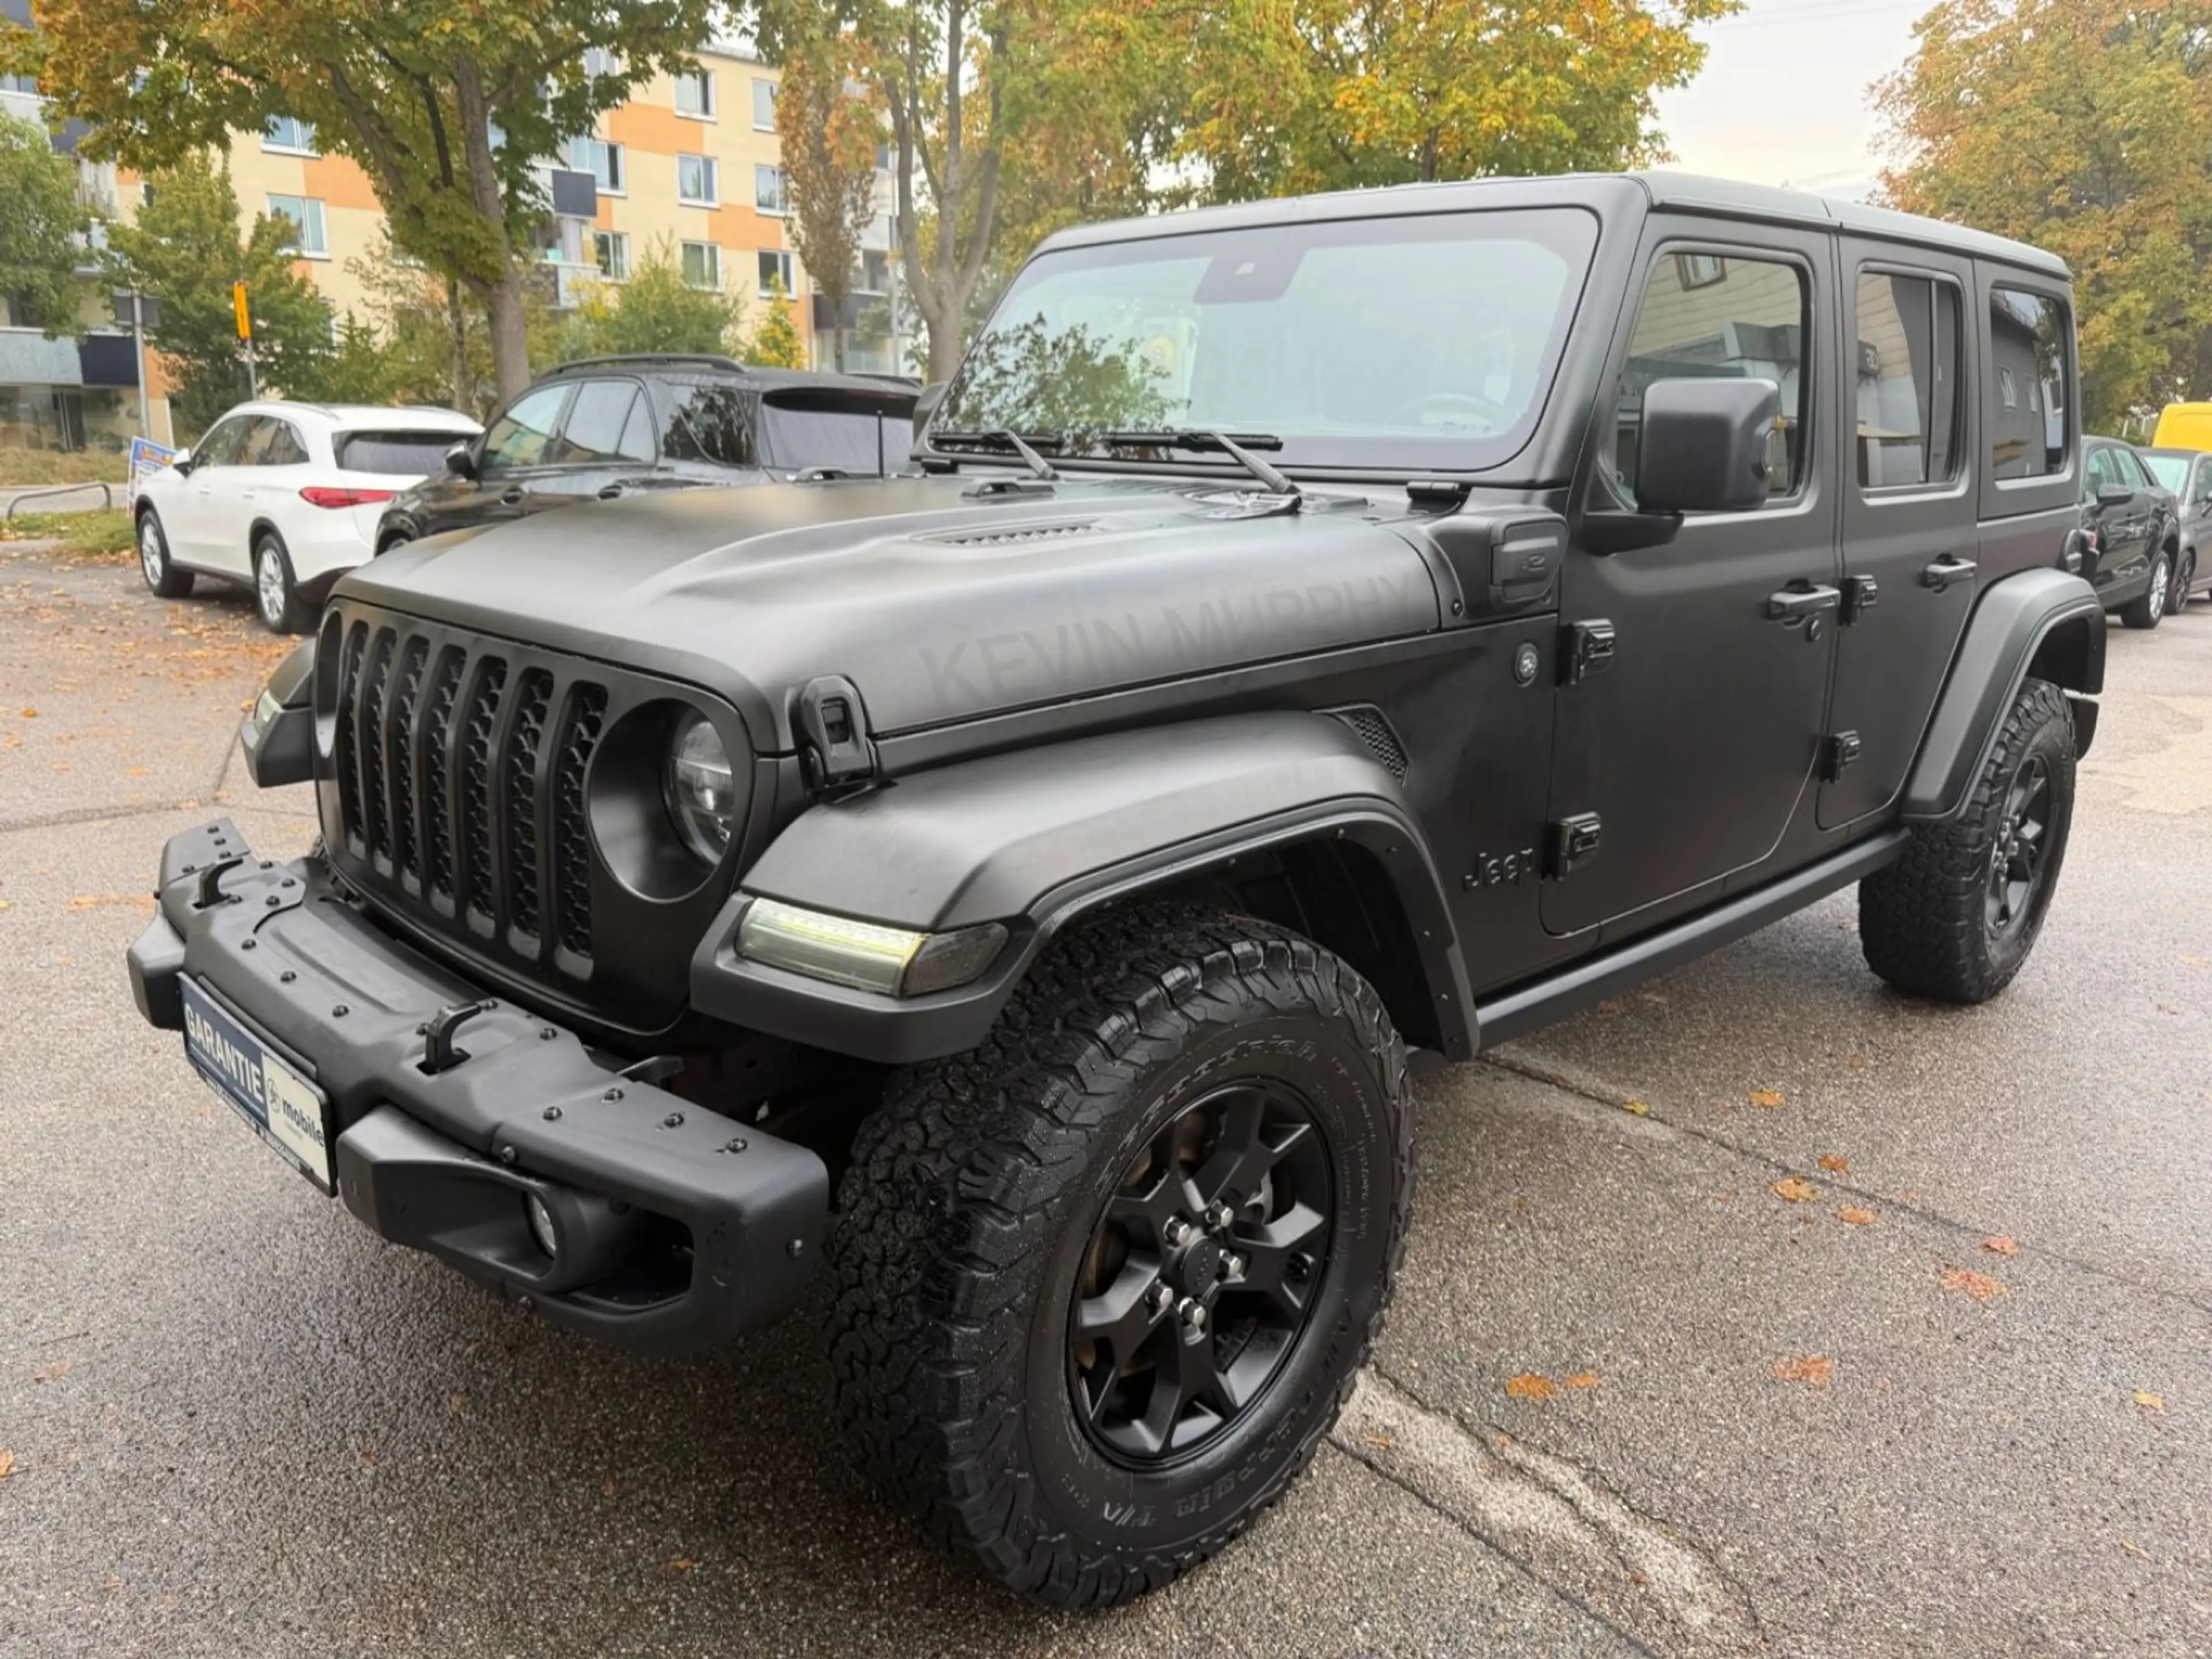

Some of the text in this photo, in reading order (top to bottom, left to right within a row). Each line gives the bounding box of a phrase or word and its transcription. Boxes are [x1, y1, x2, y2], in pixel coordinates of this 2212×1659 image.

[919, 572, 1411, 707] KEVIN MURPHY
[184, 1002, 264, 1104] GARANTIE
[282, 1097, 325, 1147] mobile
